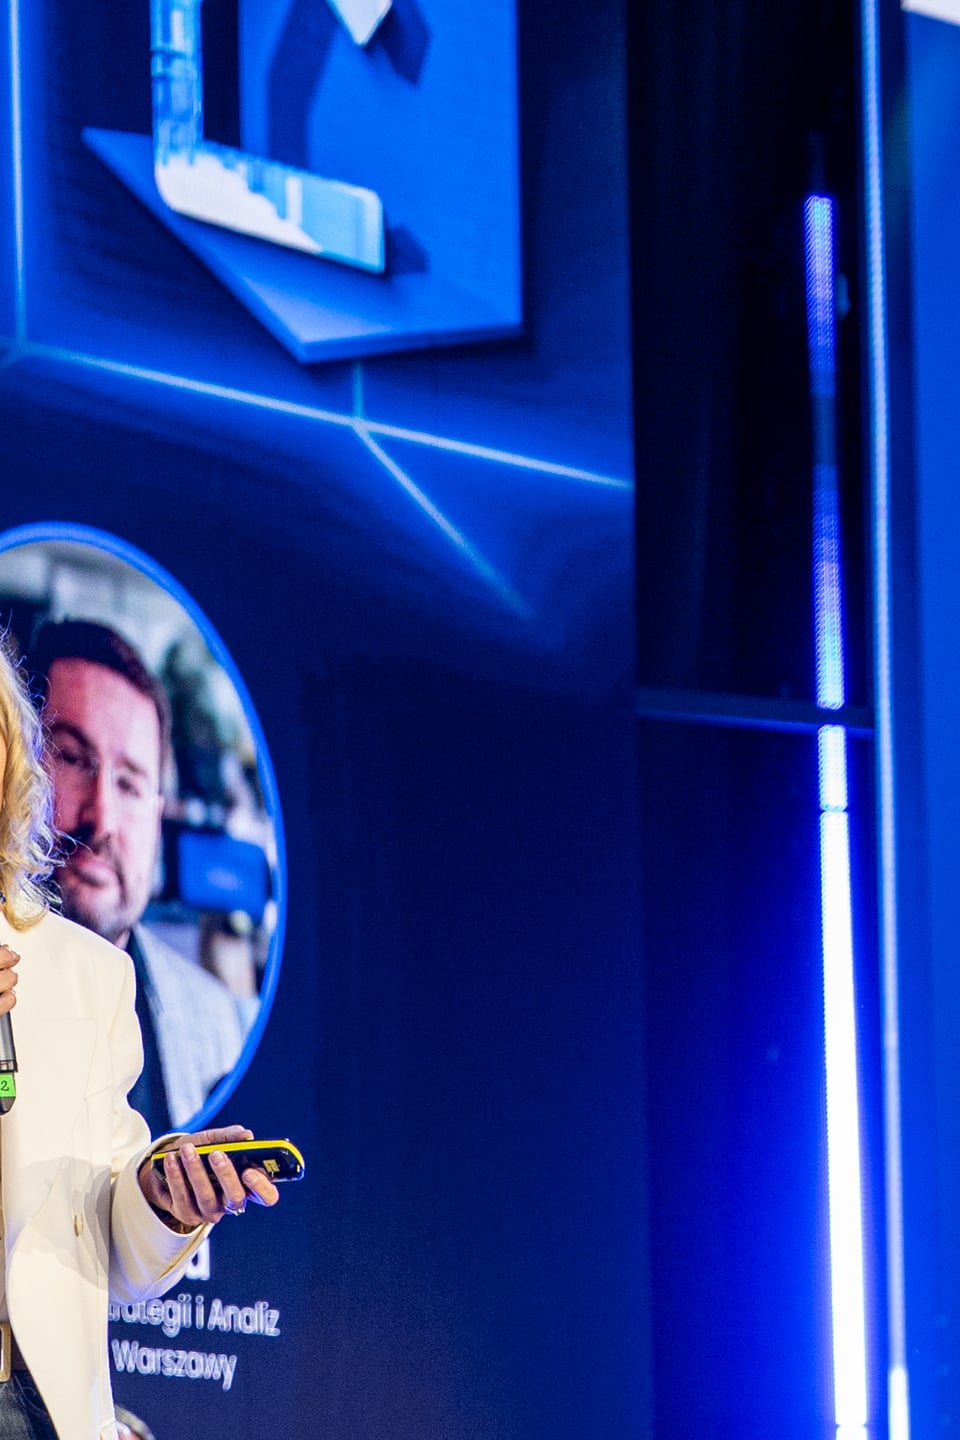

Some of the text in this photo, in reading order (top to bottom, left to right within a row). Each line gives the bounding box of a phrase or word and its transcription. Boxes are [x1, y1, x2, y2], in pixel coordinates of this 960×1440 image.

[0, 1080, 10, 1092] 2
[195, 1295, 205, 1330] i
[207, 1298, 281, 1337] Analiz
[111, 1339, 238, 1391] Warszawy
